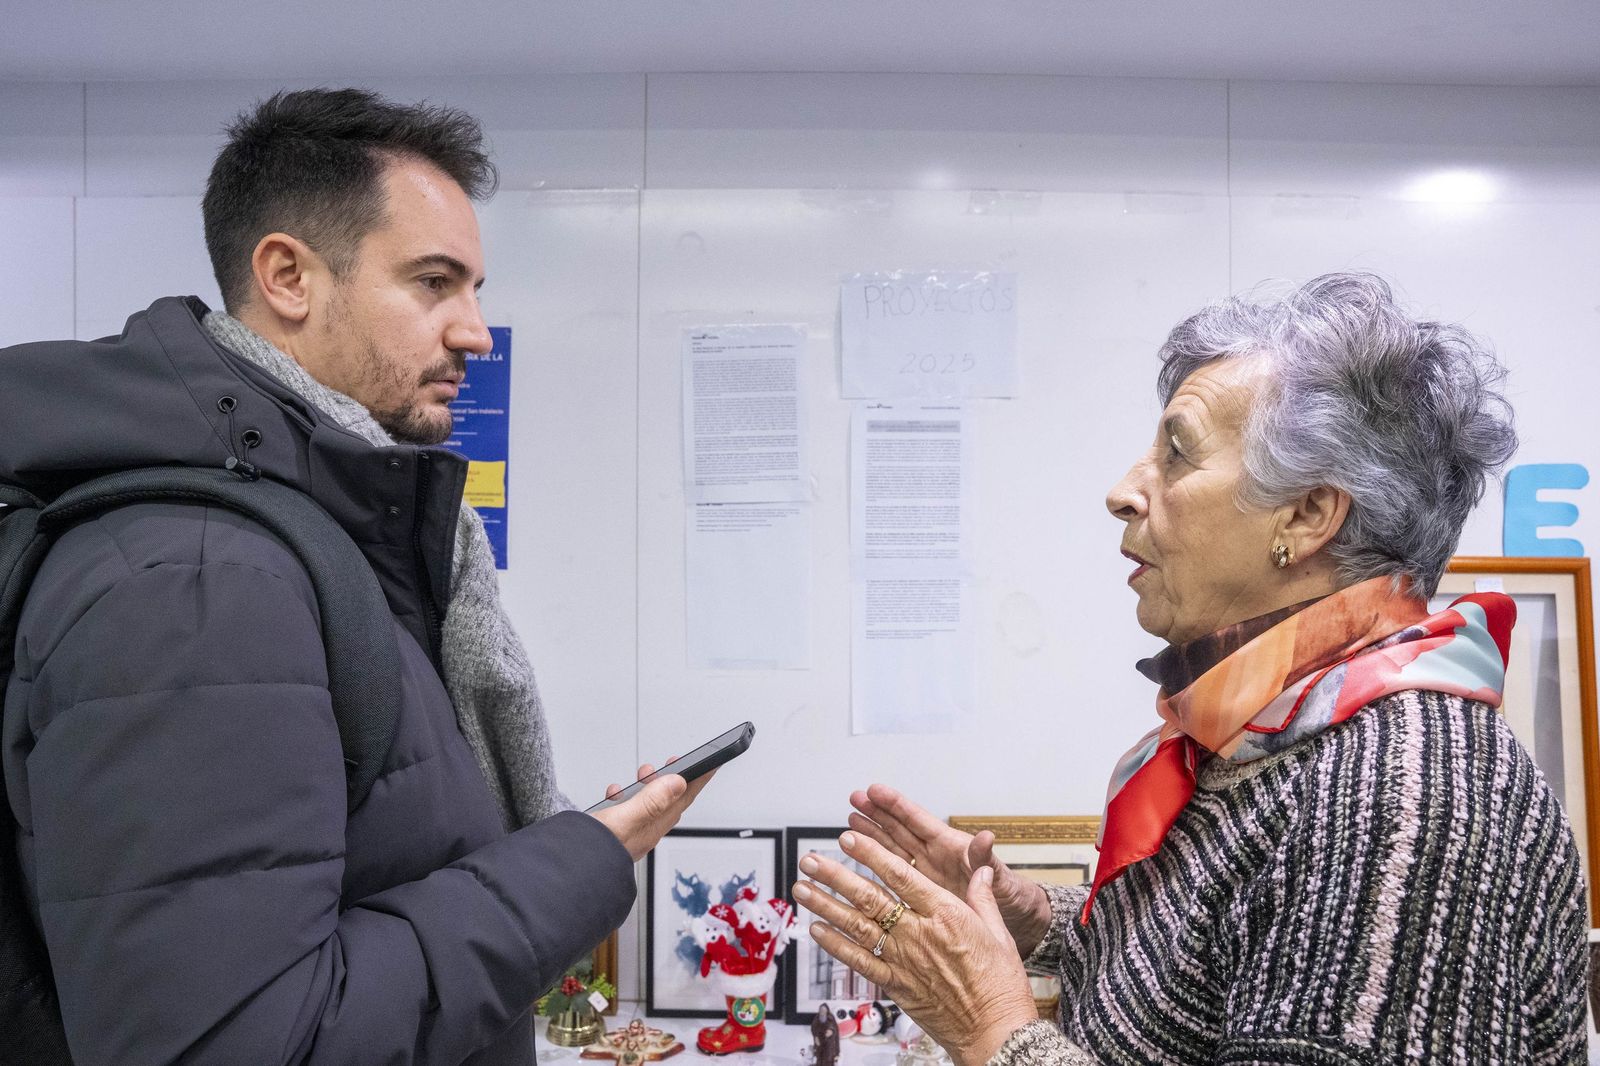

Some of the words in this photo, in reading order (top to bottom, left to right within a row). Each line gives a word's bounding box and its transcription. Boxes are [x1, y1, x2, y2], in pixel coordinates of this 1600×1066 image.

[864, 284, 1014, 319] PROYECTOS
[492, 353, 504, 361] LA
[899, 352, 975, 374] 2025
[1502, 463, 1590, 558] E
